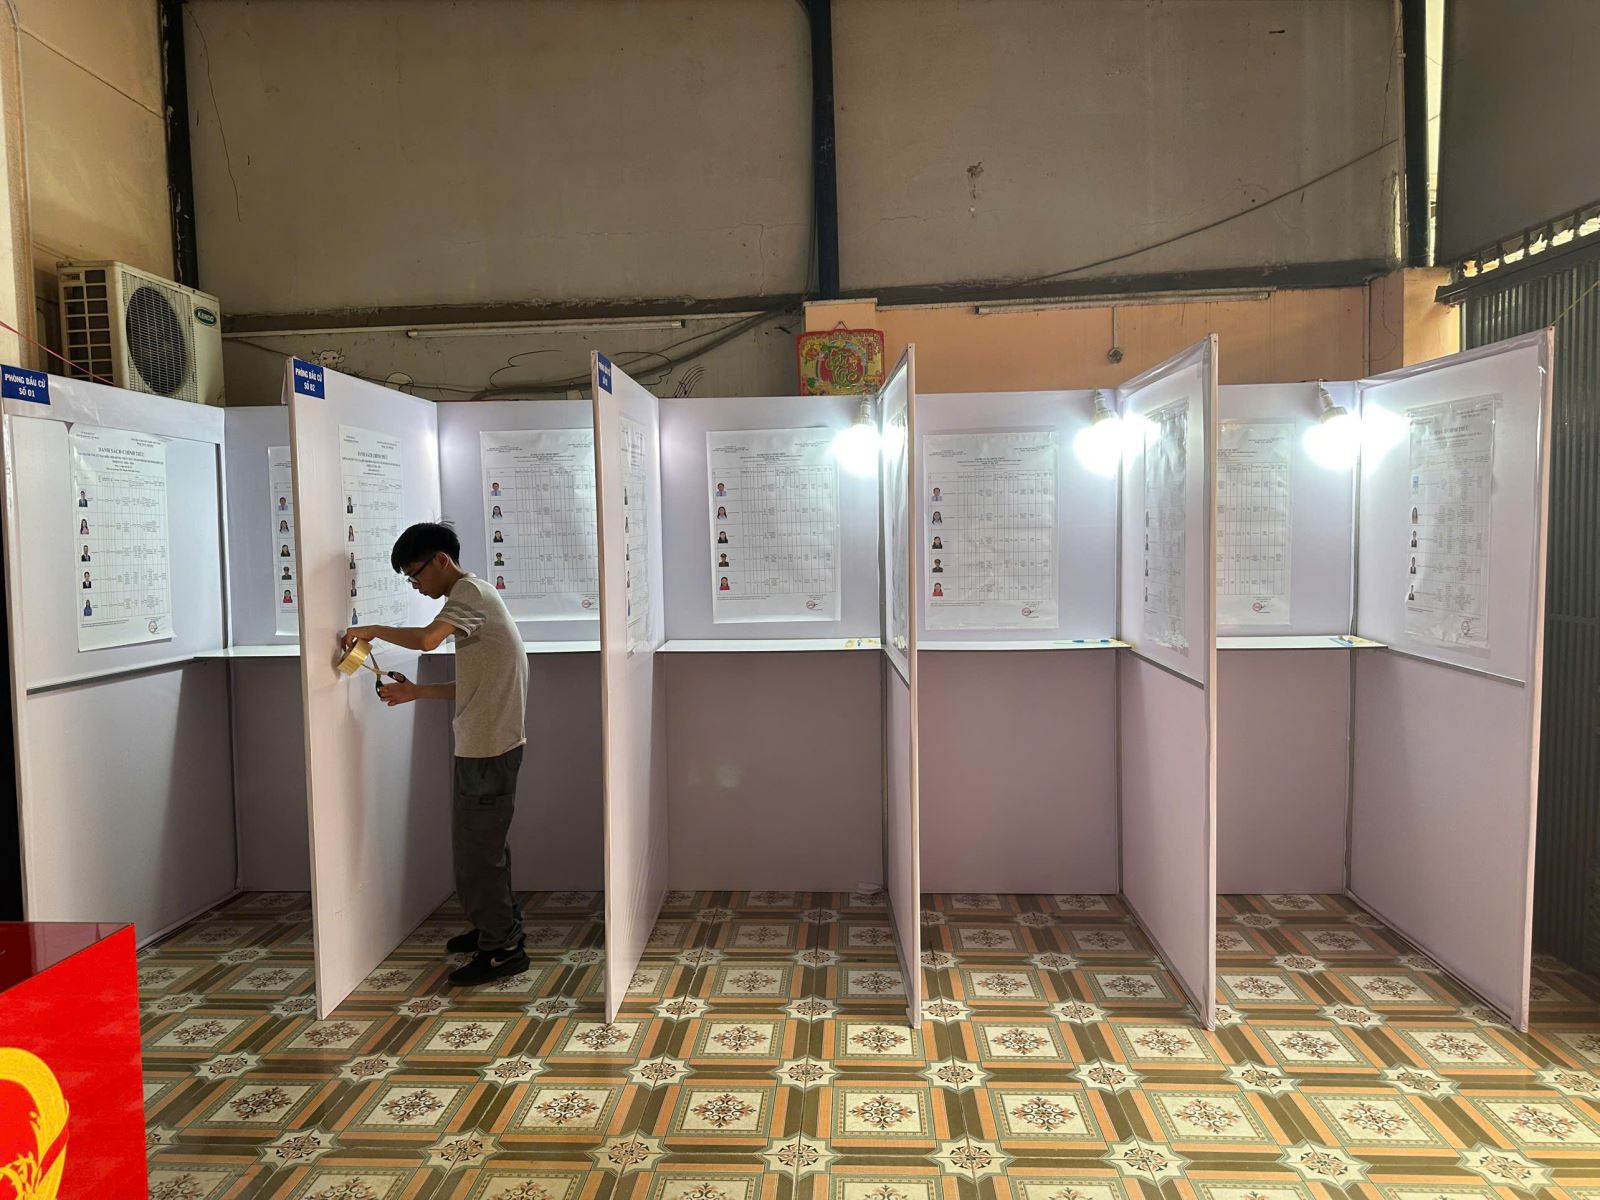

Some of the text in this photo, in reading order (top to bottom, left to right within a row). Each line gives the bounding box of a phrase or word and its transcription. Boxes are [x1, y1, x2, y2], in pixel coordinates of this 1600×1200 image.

[4, 373, 24, 385] PHÒNG
[19, 386, 35, 398] SỐ 01
